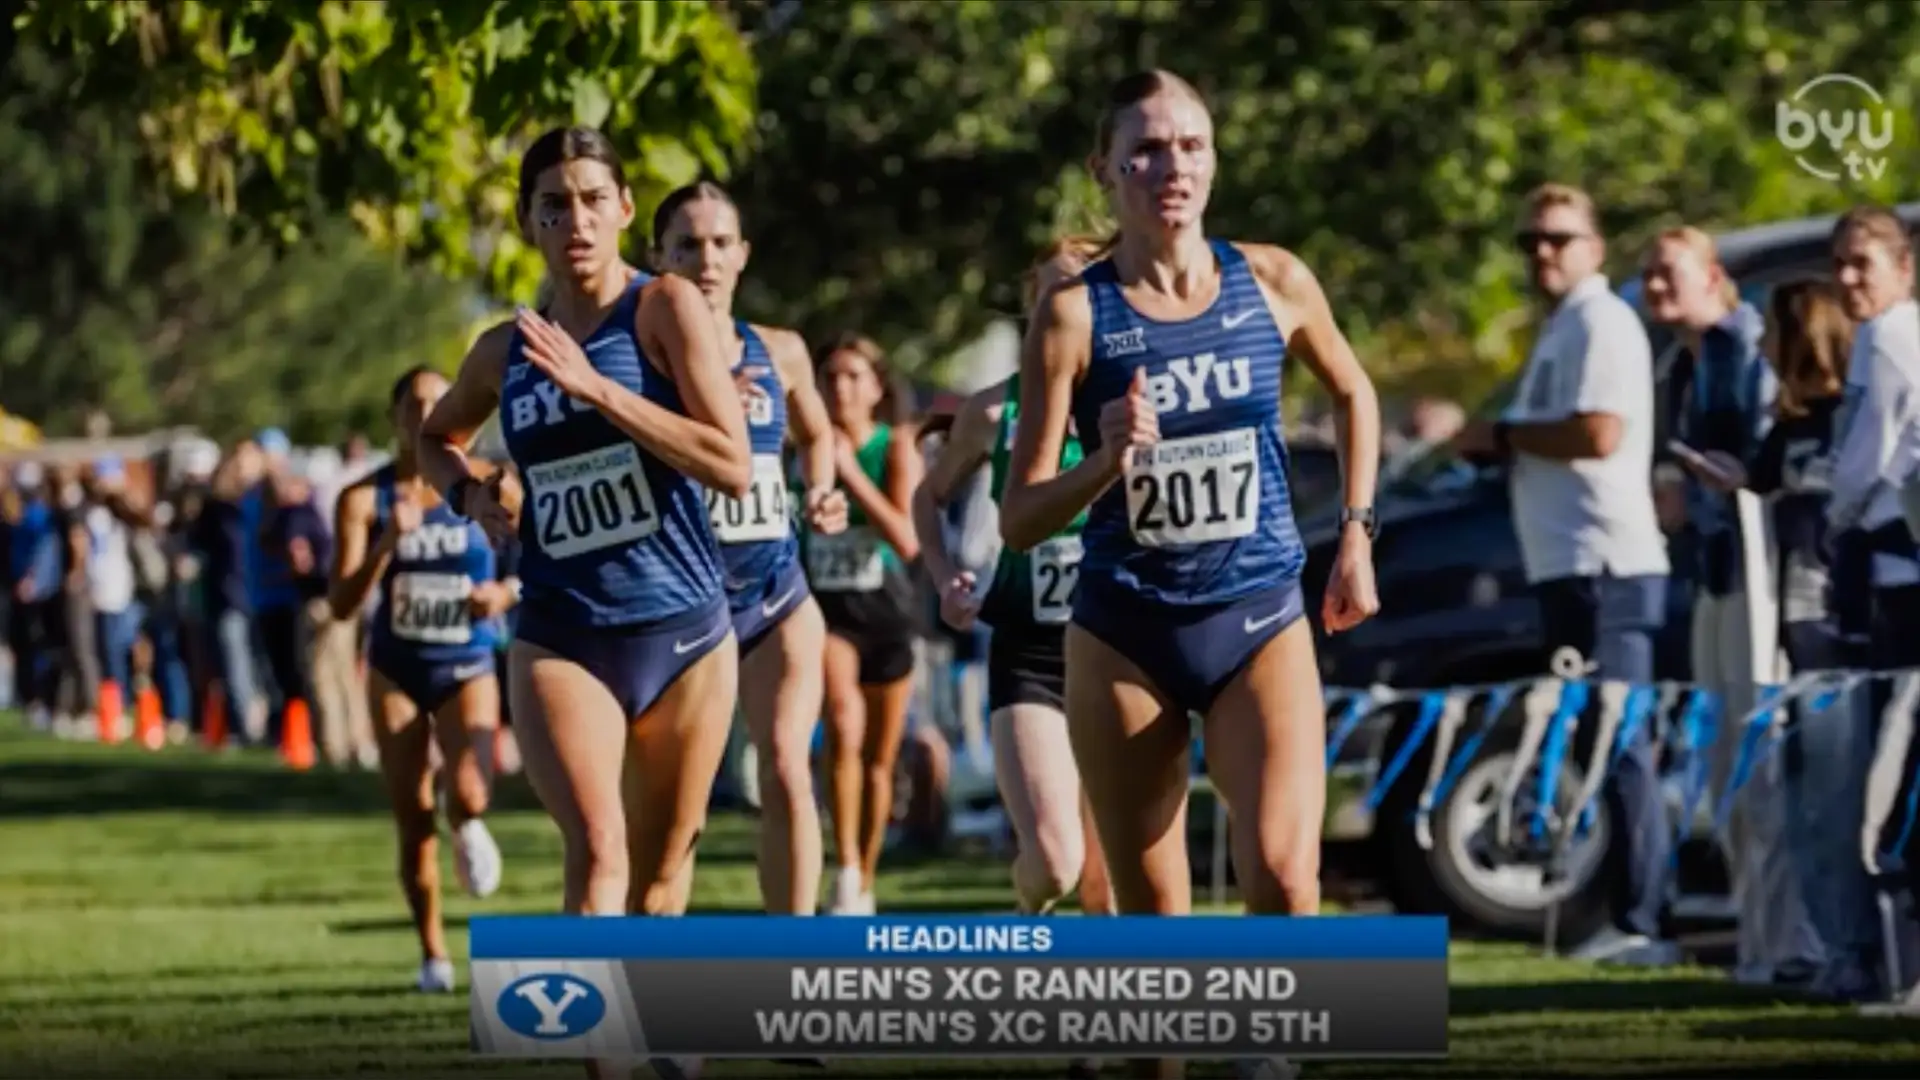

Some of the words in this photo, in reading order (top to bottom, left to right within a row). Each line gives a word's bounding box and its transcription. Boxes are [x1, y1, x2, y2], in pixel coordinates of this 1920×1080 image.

[511, 381, 596, 431] BY
[1148, 352, 1251, 412] BYU
[538, 472, 651, 546] 2001
[1132, 461, 1253, 531] 2017
